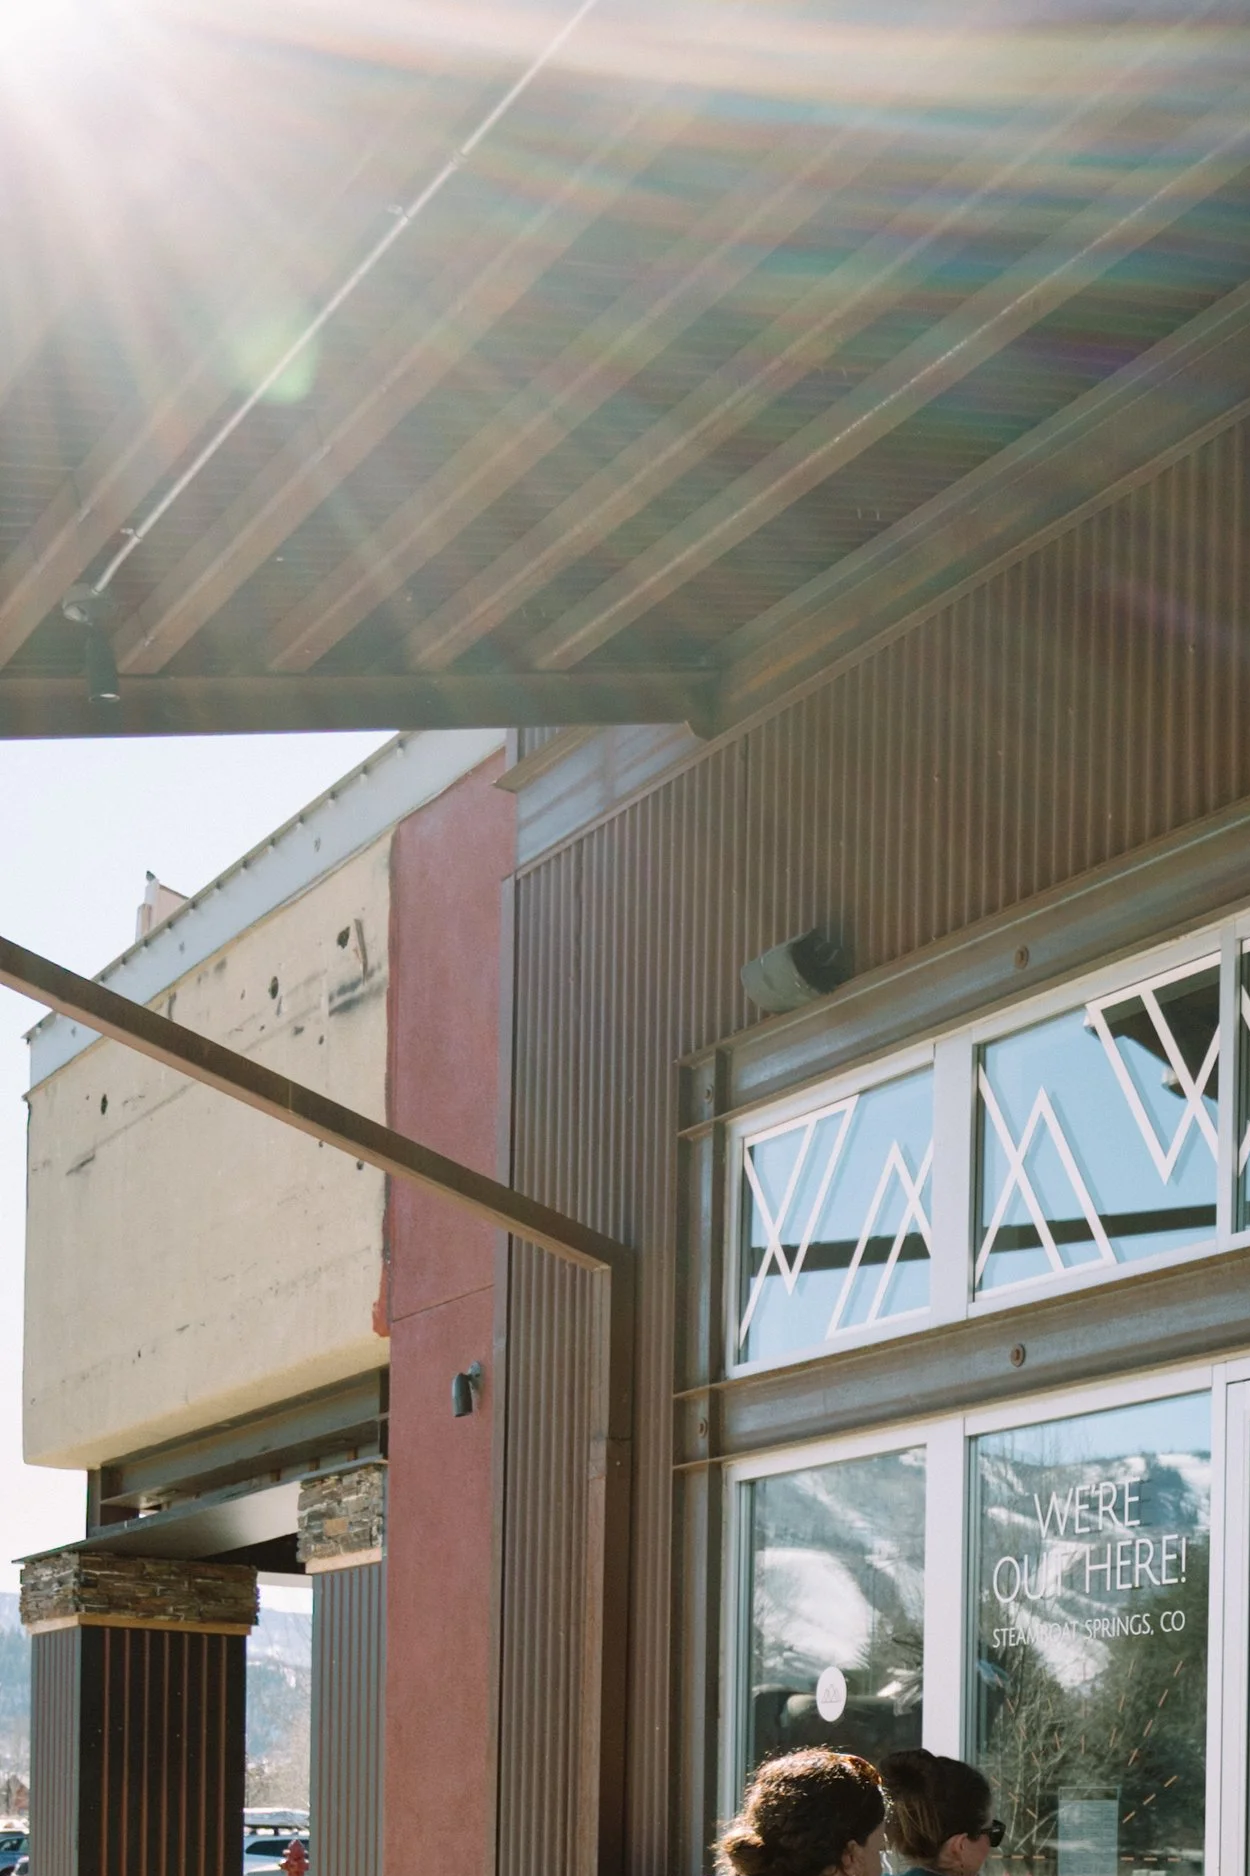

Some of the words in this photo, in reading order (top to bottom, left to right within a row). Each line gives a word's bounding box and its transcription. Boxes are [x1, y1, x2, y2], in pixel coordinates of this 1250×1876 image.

[1034, 1476, 1142, 1539] WE'RE
[993, 1550, 1073, 1603] OUT
[1085, 1533, 1187, 1594] HERE!
[992, 1619, 1078, 1648] STEAMBOAT
[1084, 1612, 1154, 1640] SPRINGS,
[1160, 1610, 1186, 1633] CO
